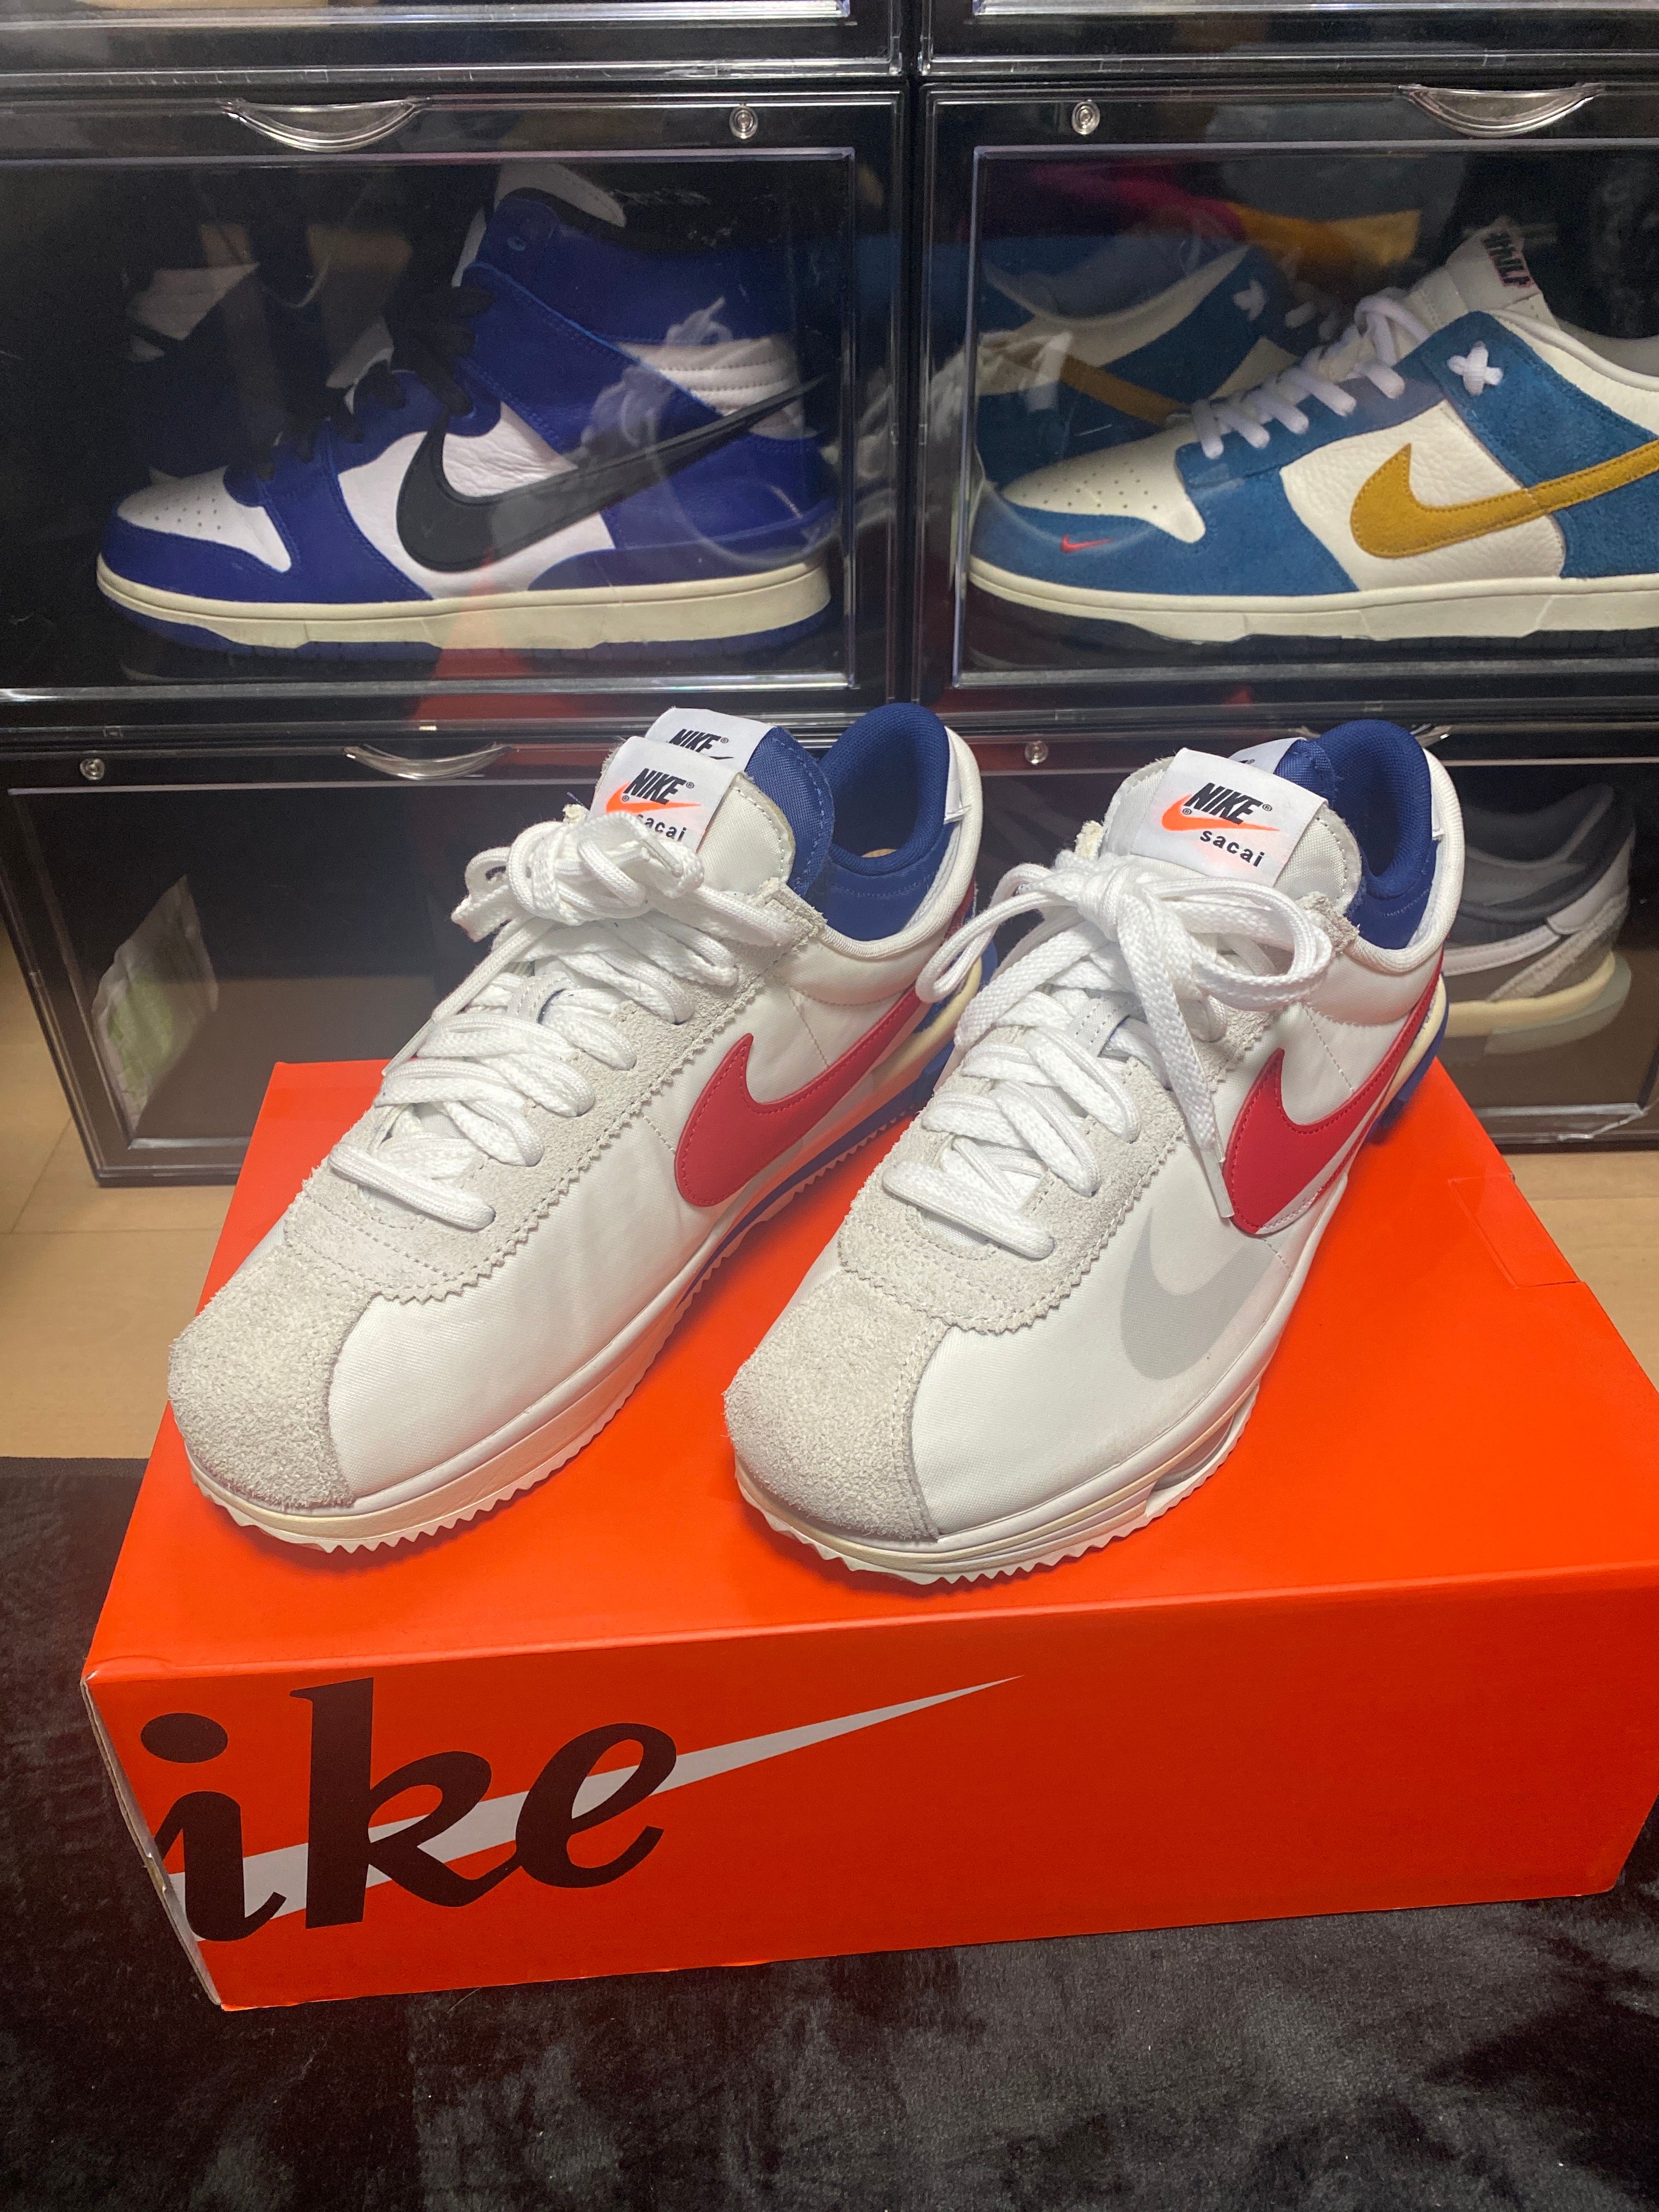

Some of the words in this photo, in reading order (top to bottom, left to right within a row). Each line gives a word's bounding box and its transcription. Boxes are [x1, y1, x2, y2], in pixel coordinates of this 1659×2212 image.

[623, 768, 687, 805] NIKE
[1183, 782, 1264, 825] NIKE
[1199, 830, 1266, 868] sacai
[140, 1677, 678, 1942] ike
